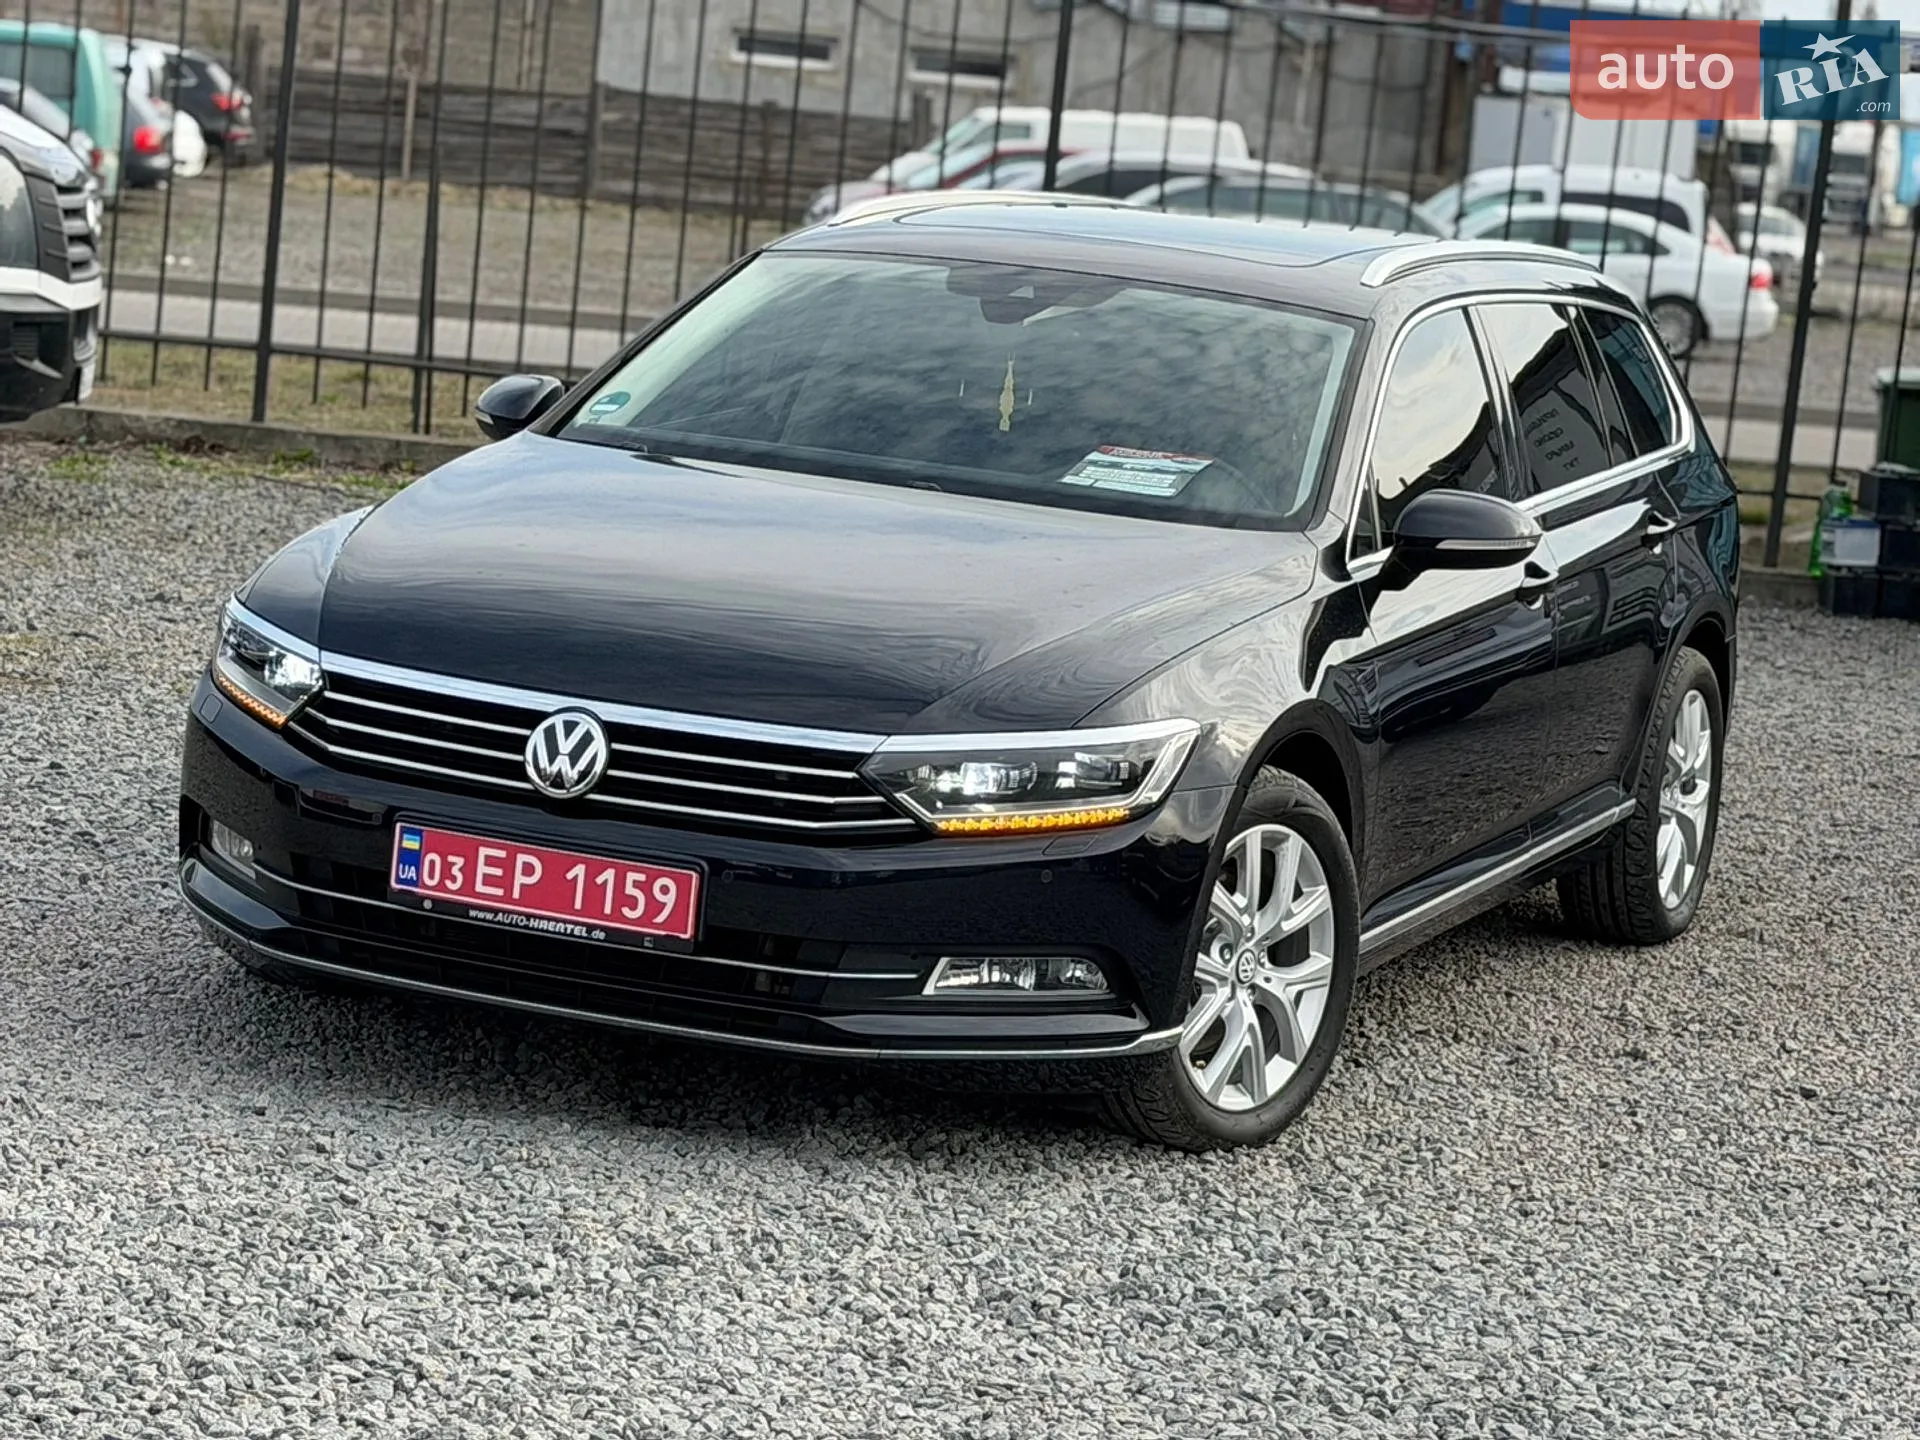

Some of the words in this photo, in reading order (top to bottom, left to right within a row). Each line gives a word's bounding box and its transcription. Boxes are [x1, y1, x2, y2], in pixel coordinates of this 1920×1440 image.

[398, 863, 418, 881] UA
[422, 852, 465, 891] 03
[474, 846, 543, 900] EP
[565, 863, 677, 924] 1159
